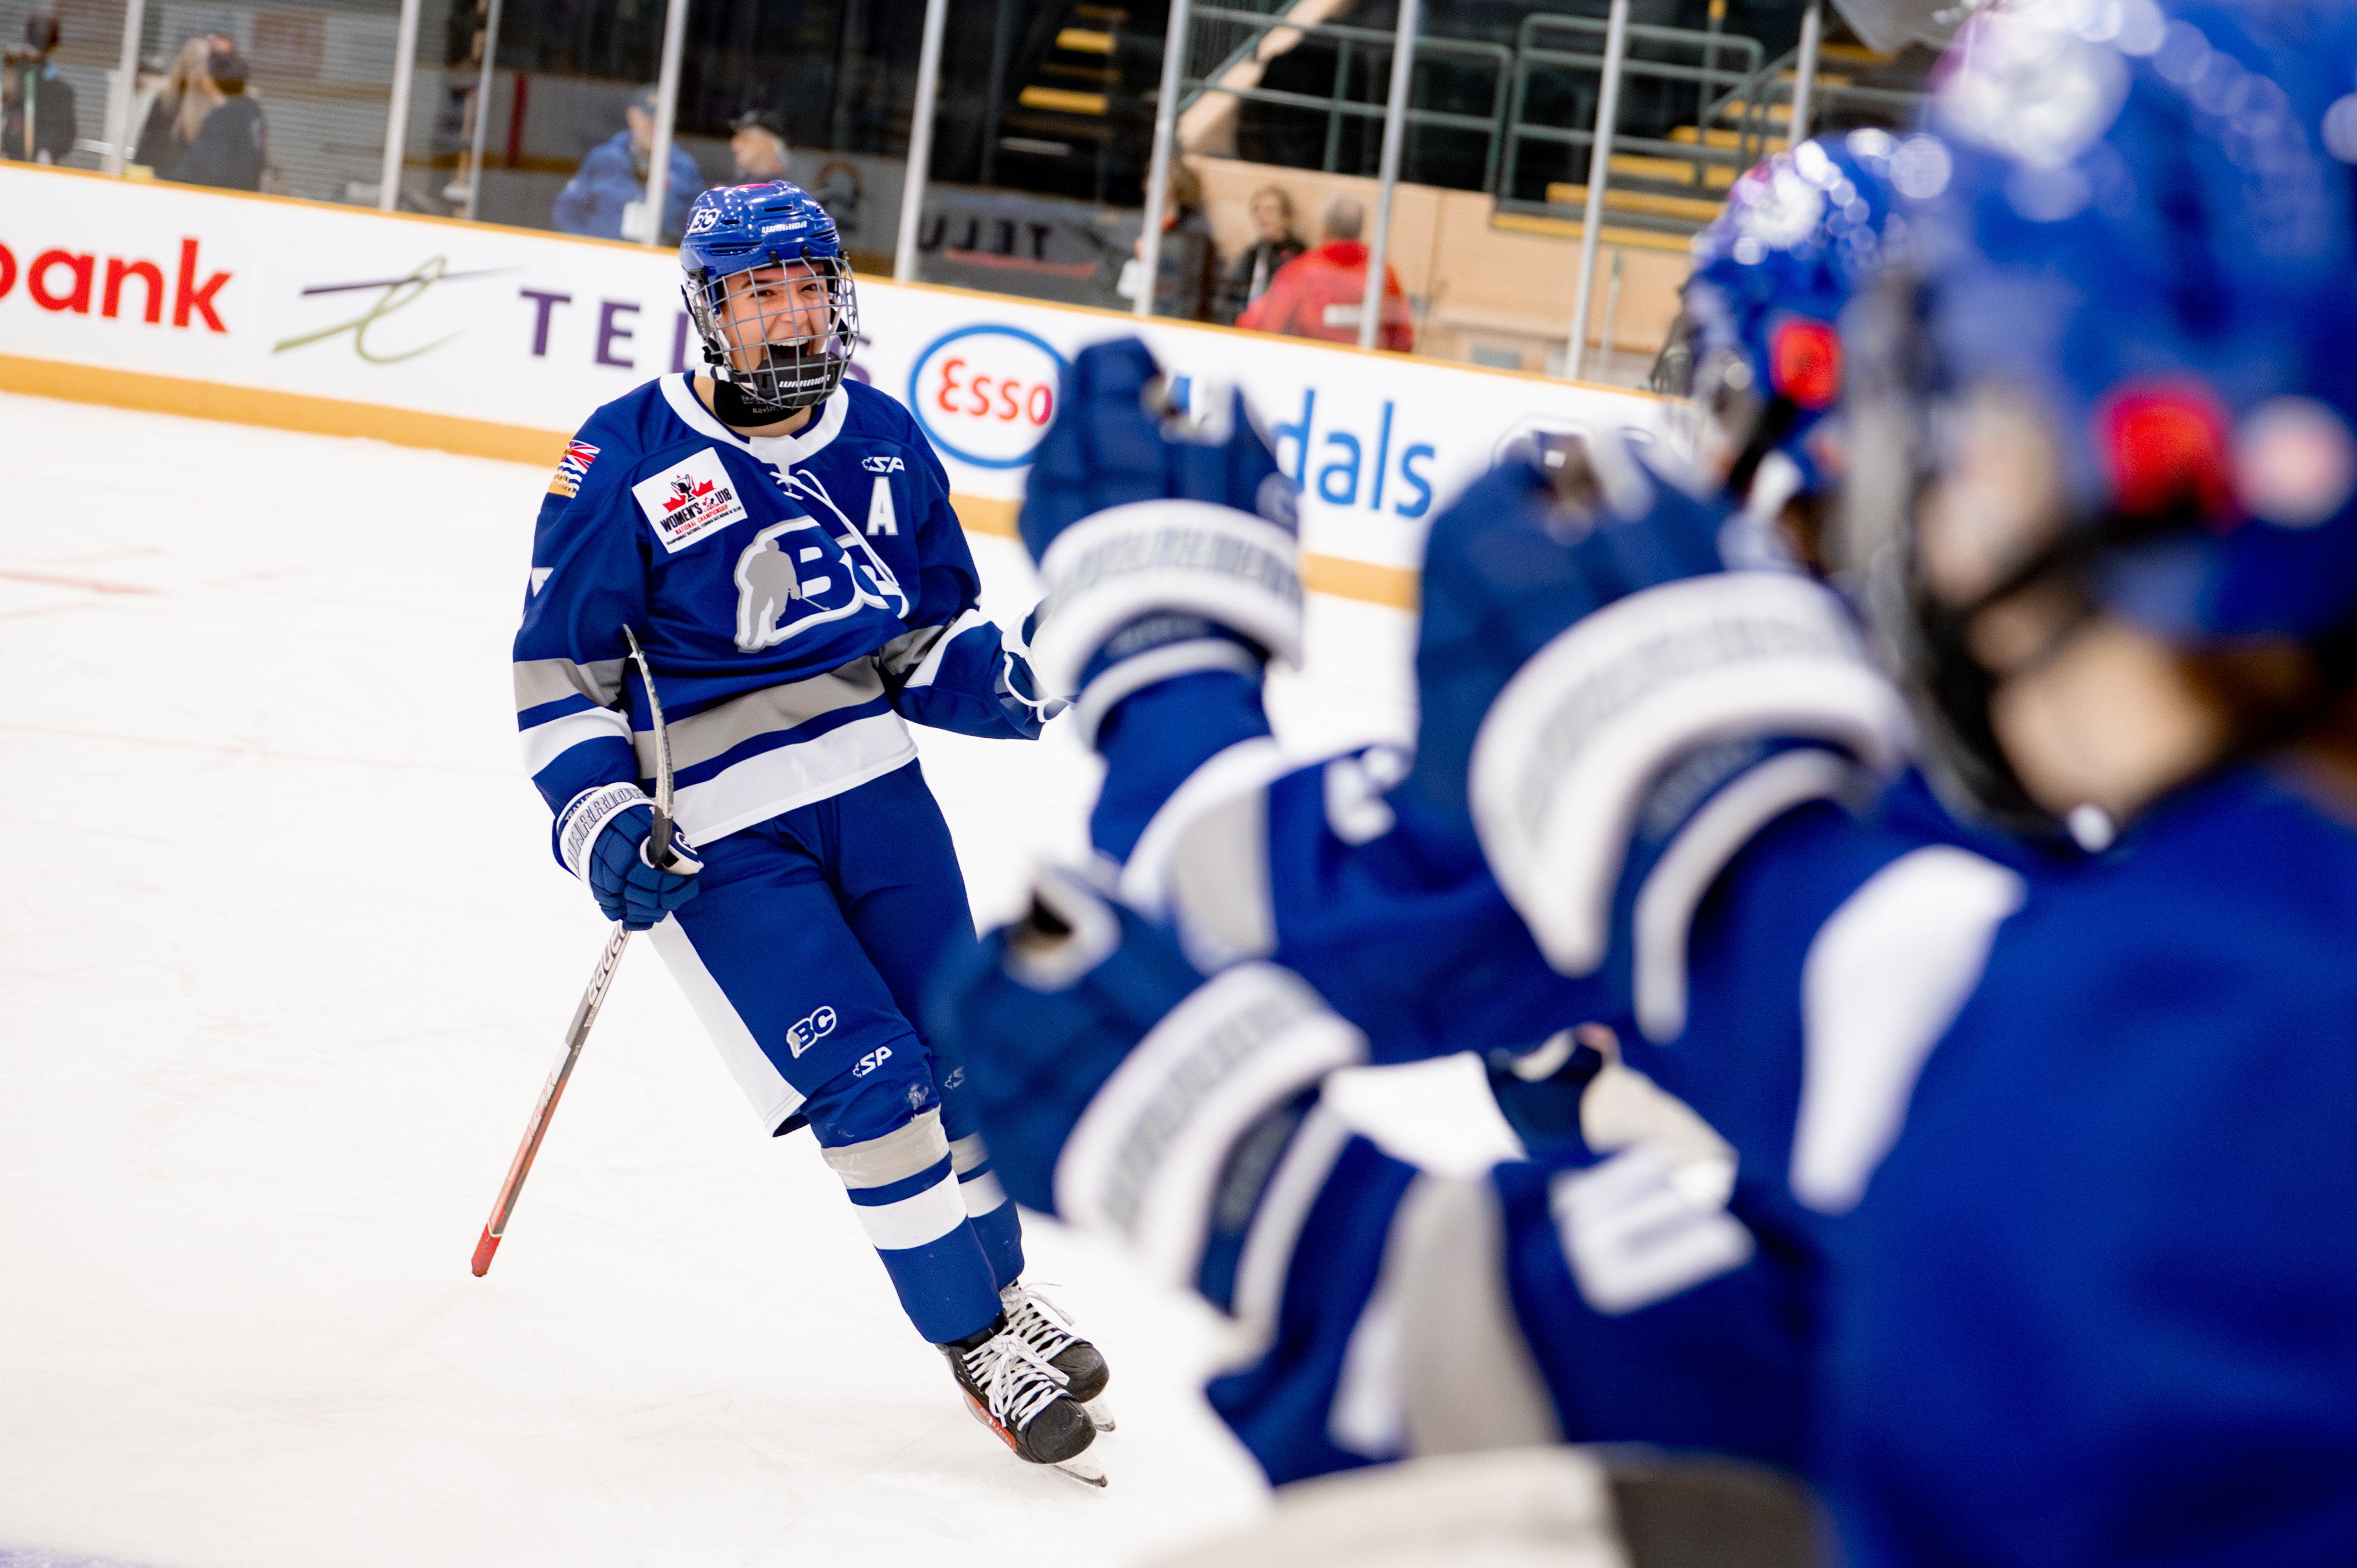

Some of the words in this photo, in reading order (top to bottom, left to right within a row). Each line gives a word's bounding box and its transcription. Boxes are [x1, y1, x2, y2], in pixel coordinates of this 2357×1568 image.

[762, 220, 808, 233] WARRIOR
[0, 236, 235, 334] ank
[936, 358, 1054, 426] Esso
[660, 502, 703, 533] WOMEN'S
[714, 488, 733, 504] U18
[866, 476, 898, 535] A
[786, 1005, 837, 1059] BC
